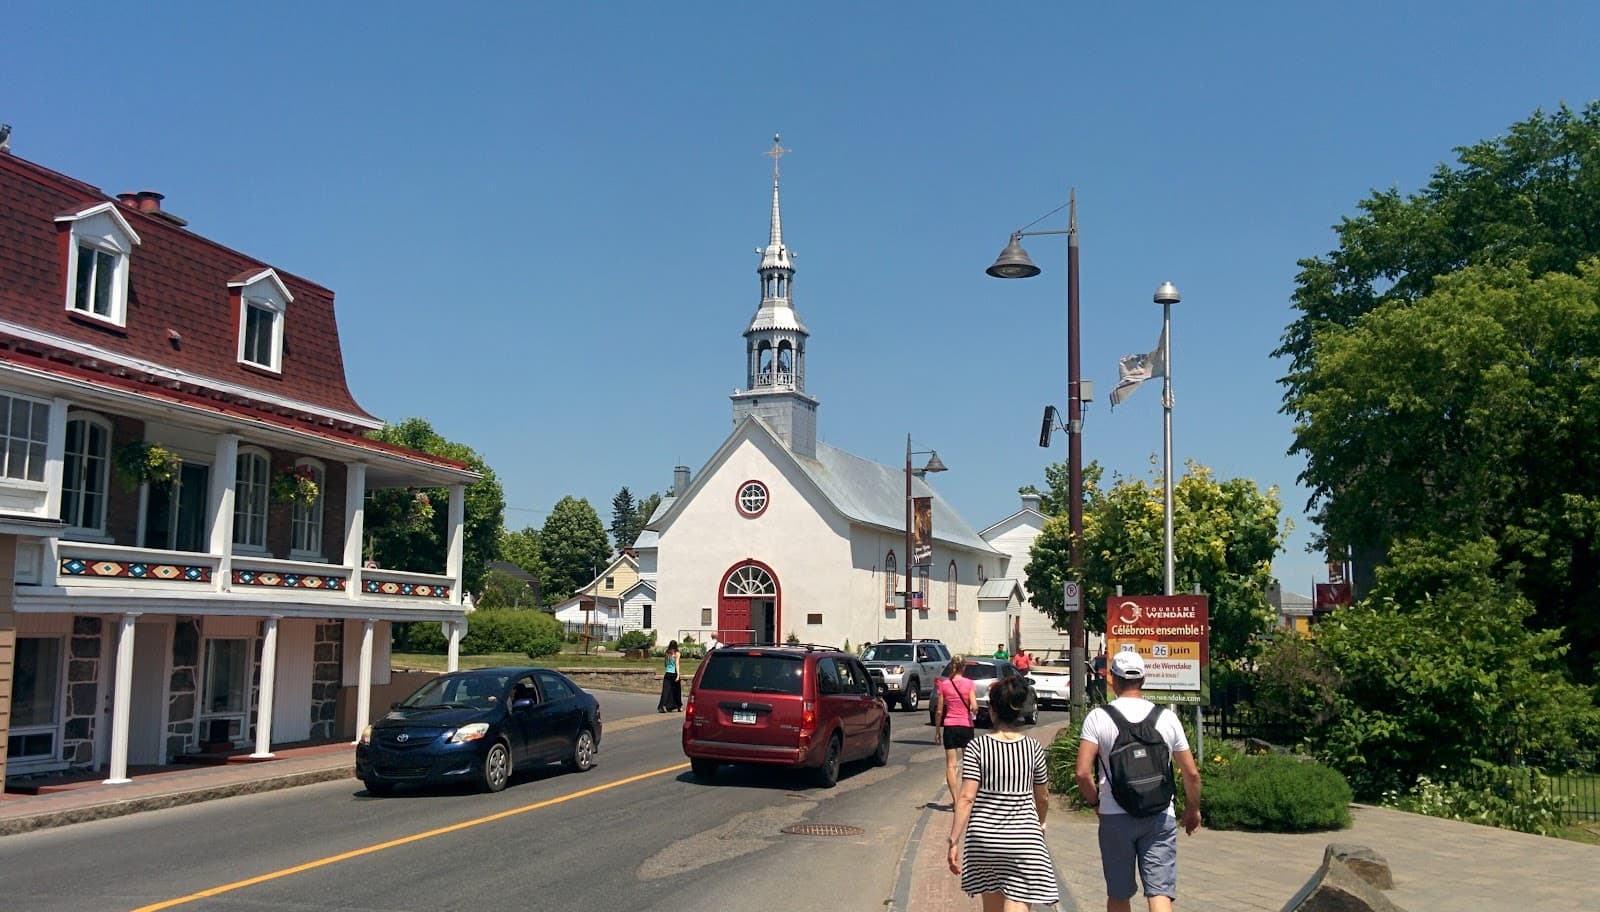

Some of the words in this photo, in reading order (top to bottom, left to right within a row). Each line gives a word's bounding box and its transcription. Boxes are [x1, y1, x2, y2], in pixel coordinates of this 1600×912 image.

[1111, 624, 1155, 635] Célébrons
[1156, 624, 1199, 635] ensemble
[1154, 646, 1167, 656] 26
[1169, 646, 1190, 656] juin
[1152, 662, 1161, 670] de
[1161, 662, 1192, 670] Wendake
